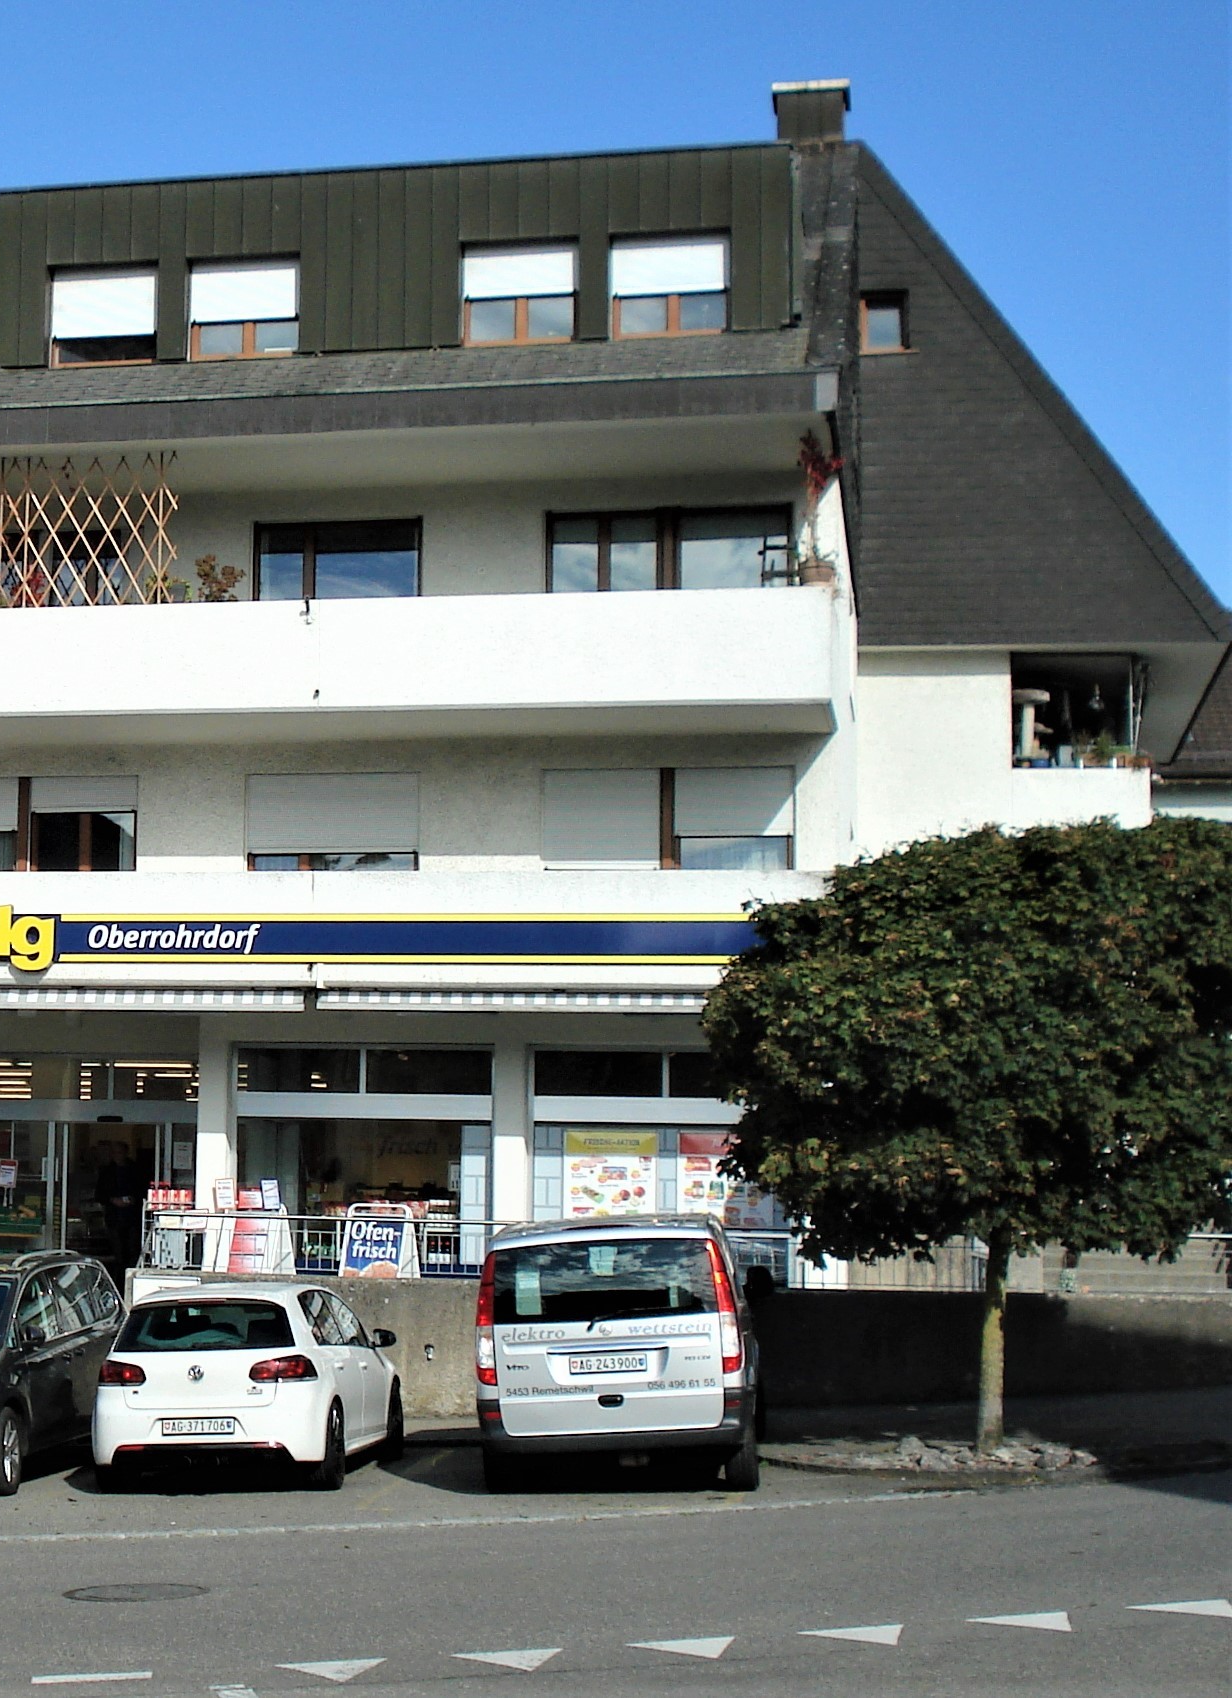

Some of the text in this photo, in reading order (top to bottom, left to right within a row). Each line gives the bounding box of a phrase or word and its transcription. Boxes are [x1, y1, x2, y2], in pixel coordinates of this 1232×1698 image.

[87, 922, 259, 954] Oberrohrdorf
[351, 1221, 402, 1241] Ofen-
[352, 1240, 397, 1259] frisch
[501, 1321, 712, 1342] elektro wettstein
[506, 1384, 594, 1397] 5453 Remetschwil
[647, 1378, 716, 1390] 056 496 61 55
